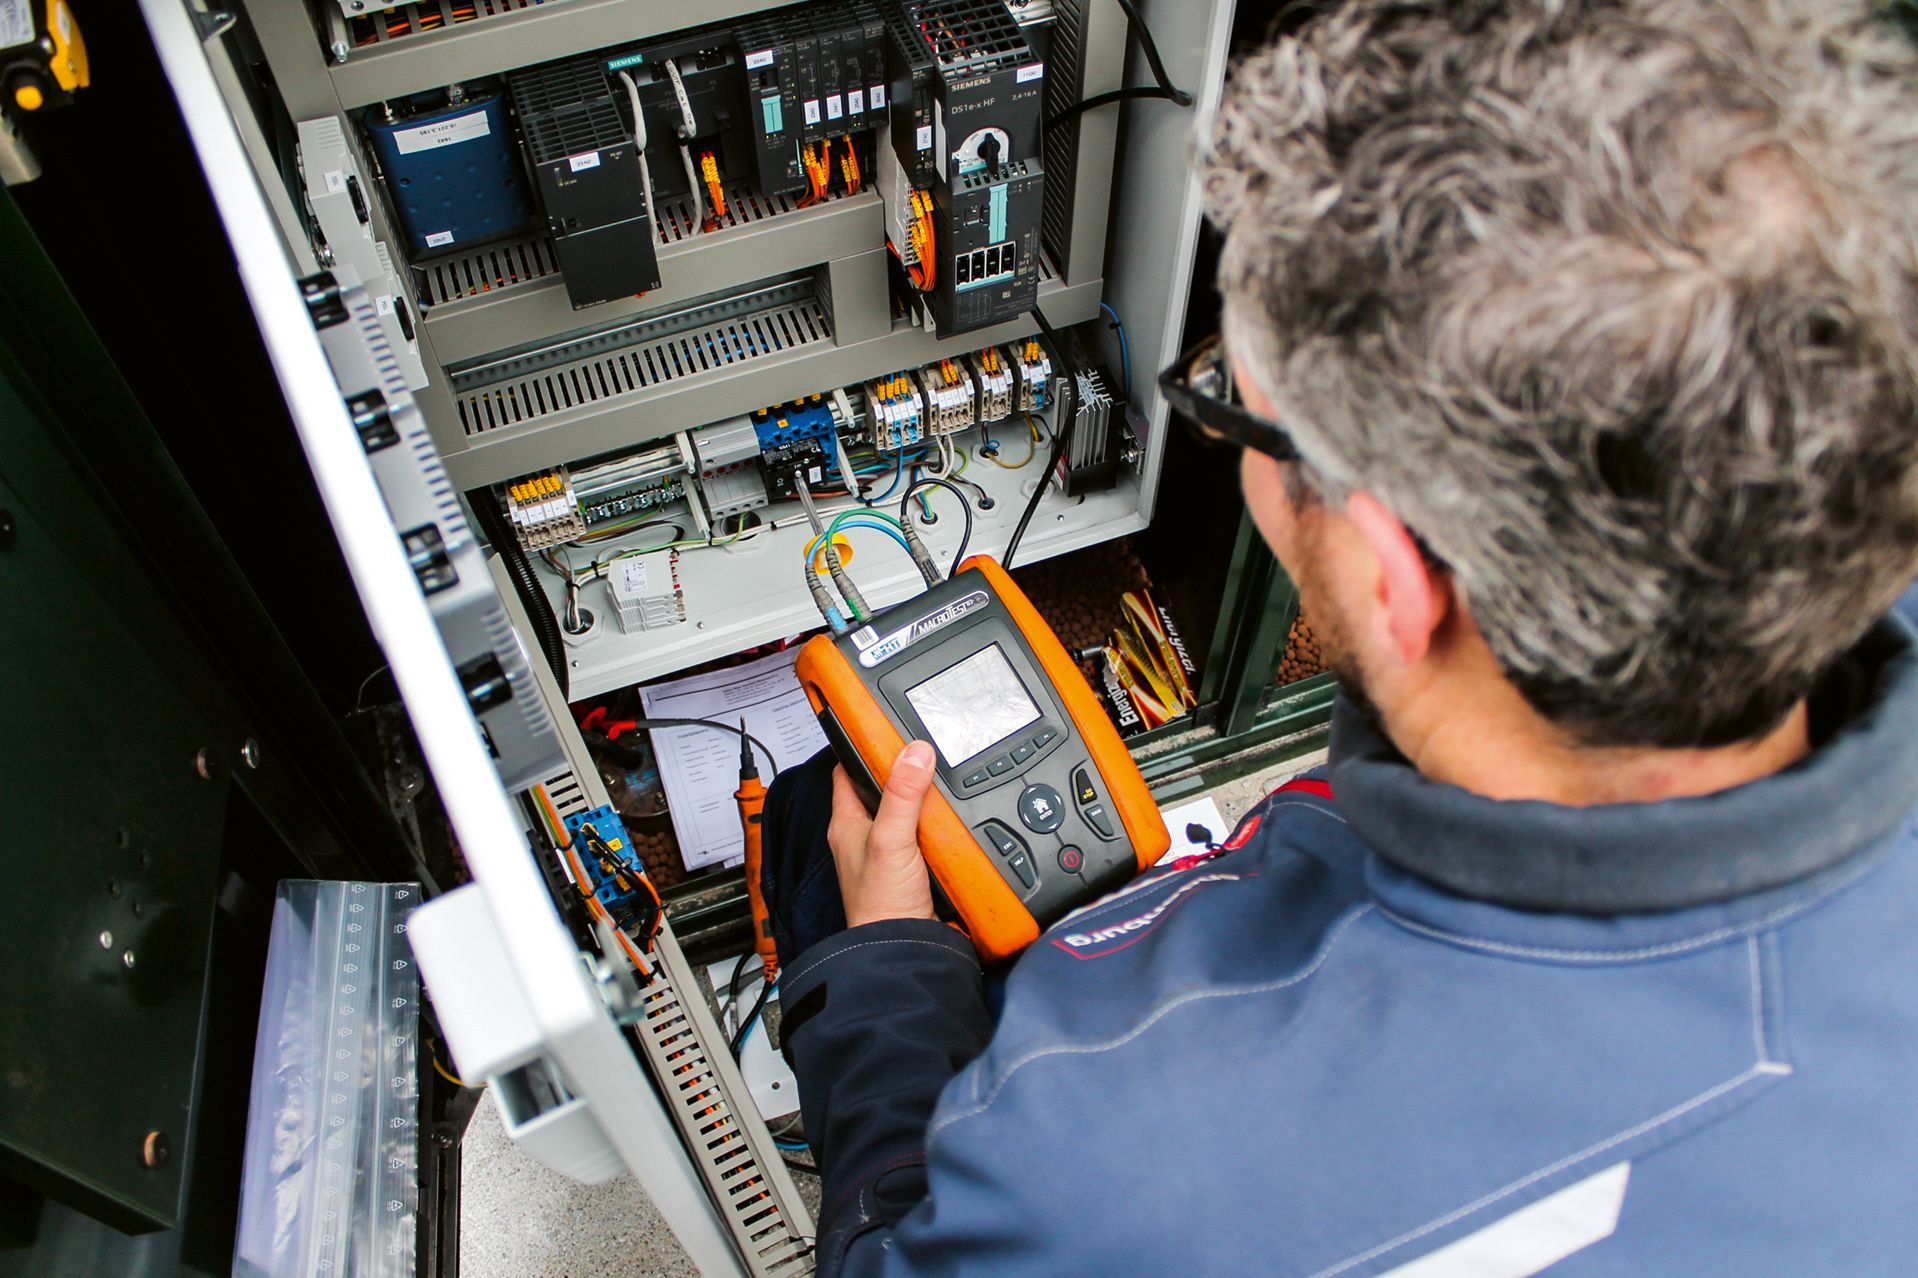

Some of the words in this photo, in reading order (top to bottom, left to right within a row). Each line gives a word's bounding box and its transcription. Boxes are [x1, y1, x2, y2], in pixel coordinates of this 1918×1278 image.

[610, 56, 642, 68] SIEMENS
[951, 77, 991, 92] SIEMENS
[951, 101, 982, 115] DS1e-x
[983, 97, 996, 108] HF
[918, 604, 968, 635] MACROTEST
[1105, 679, 1140, 727] Energiz
[1083, 791, 1095, 799] STOP
[1039, 810, 1053, 820] ENTER
[1003, 842, 1013, 850] ESC
[1014, 857, 1023, 866] HELP
